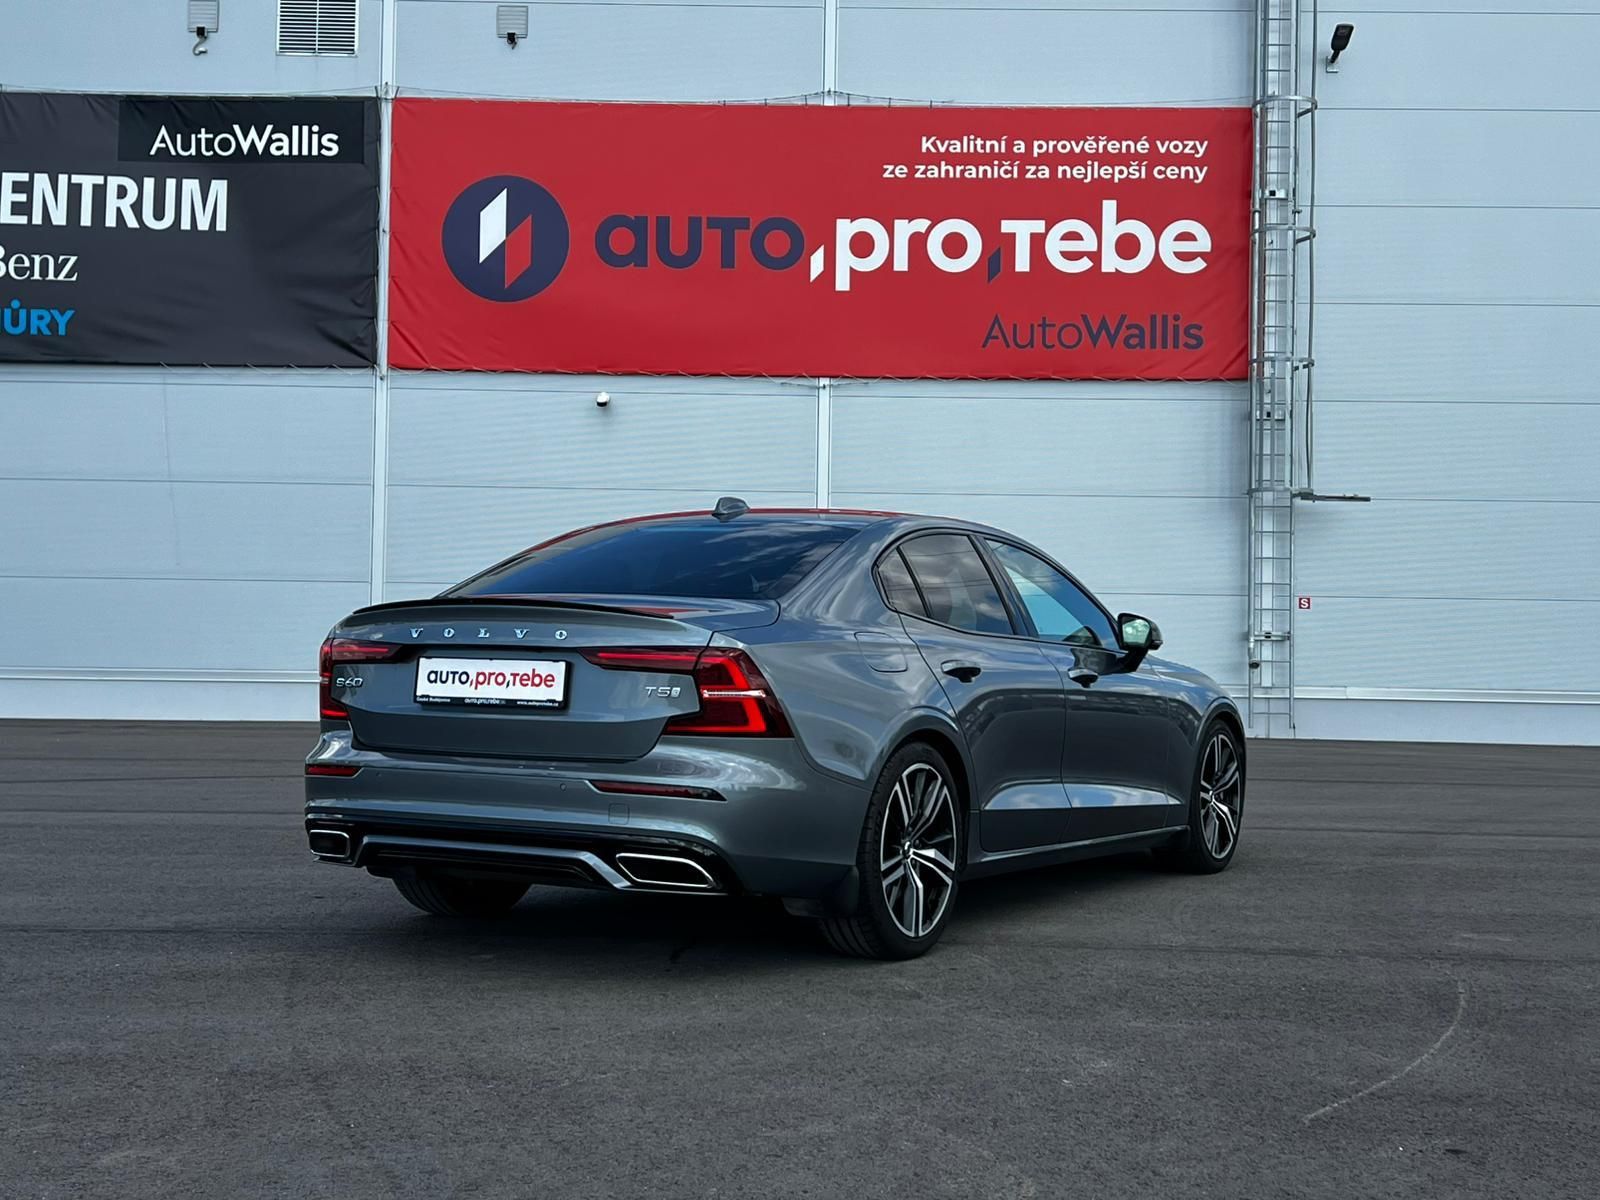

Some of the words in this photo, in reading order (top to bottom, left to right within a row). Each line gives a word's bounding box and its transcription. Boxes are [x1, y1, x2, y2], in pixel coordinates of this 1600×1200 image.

[149, 124, 340, 157] AutoWallis
[921, 135, 1007, 154] Kvalitní
[1013, 140, 1026, 154] a
[1033, 135, 1150, 158] prověřené
[1156, 140, 1209, 158] vozy
[883, 164, 908, 179] ze
[914, 160, 1020, 179] zahraničí
[1025, 165, 1050, 179] za
[1057, 160, 1147, 184] nejlepší
[1152, 165, 1208, 184] ceny
[0, 172, 229, 232] ENTRUM
[982, 313, 1205, 350] AutoWallis
[1300, 598, 1309, 609] S
[336, 677, 363, 687] S60
[645, 686, 671, 697] T5
